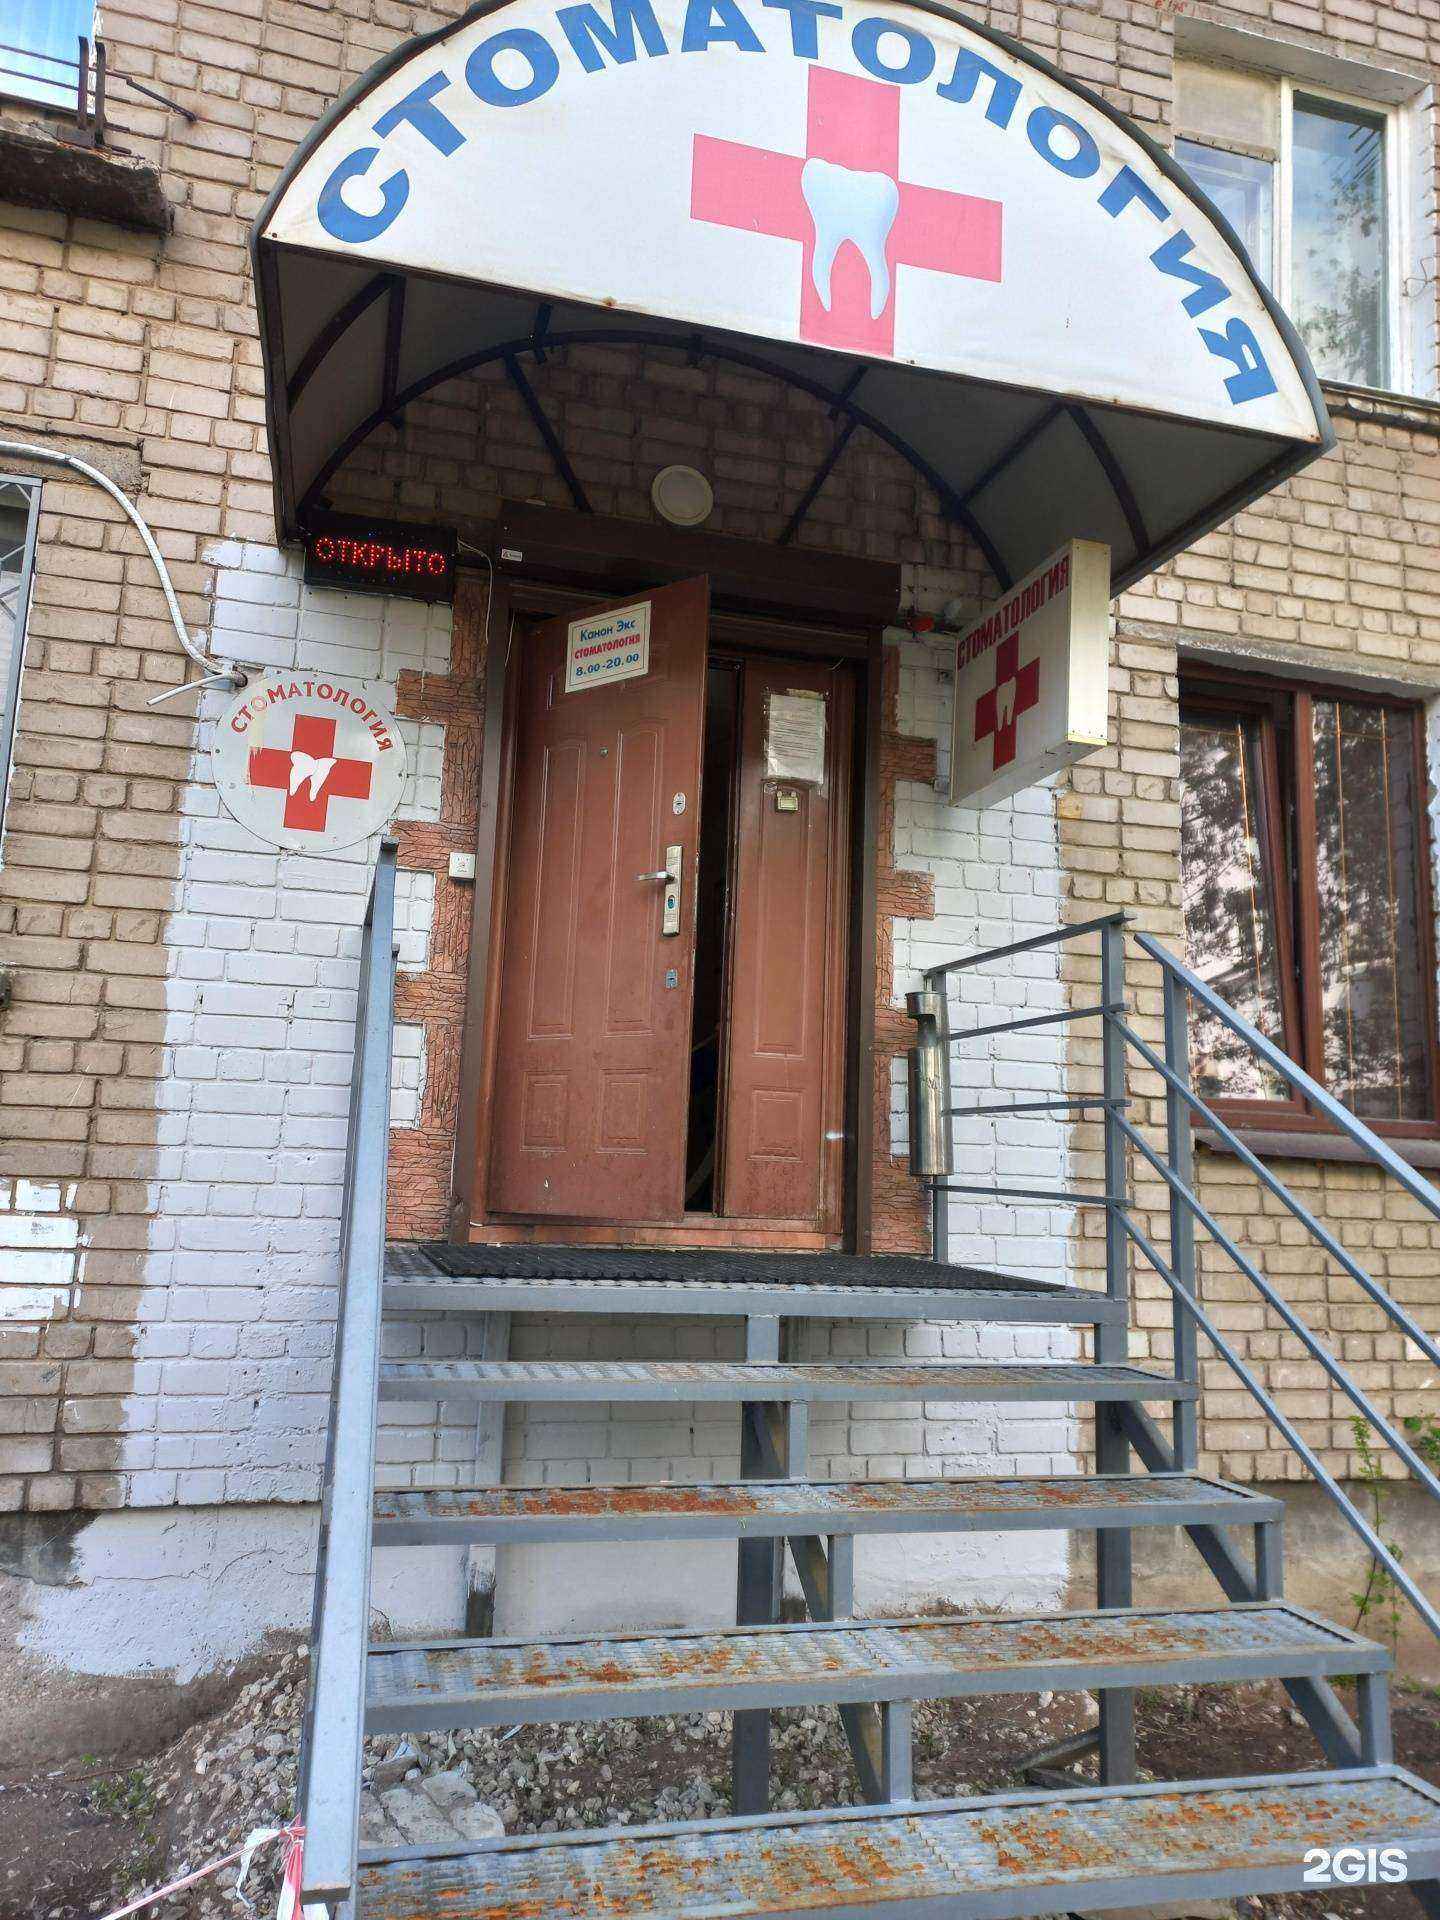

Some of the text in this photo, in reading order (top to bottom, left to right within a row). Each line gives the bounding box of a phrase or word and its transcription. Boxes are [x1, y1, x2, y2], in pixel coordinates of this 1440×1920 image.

[317, 0, 1278, 405] СТОМАТОЛОГИЯ
[314, 537, 446, 576] ОТКРЫТО
[580, 620, 636, 641] Канон Экс
[956, 554, 1070, 671] СТОМАТОЛОГИЯ
[574, 634, 641, 659] СТОМАТОЛОГИЯ
[231, 681, 394, 752] СТОМАТОЛОГИЯ
